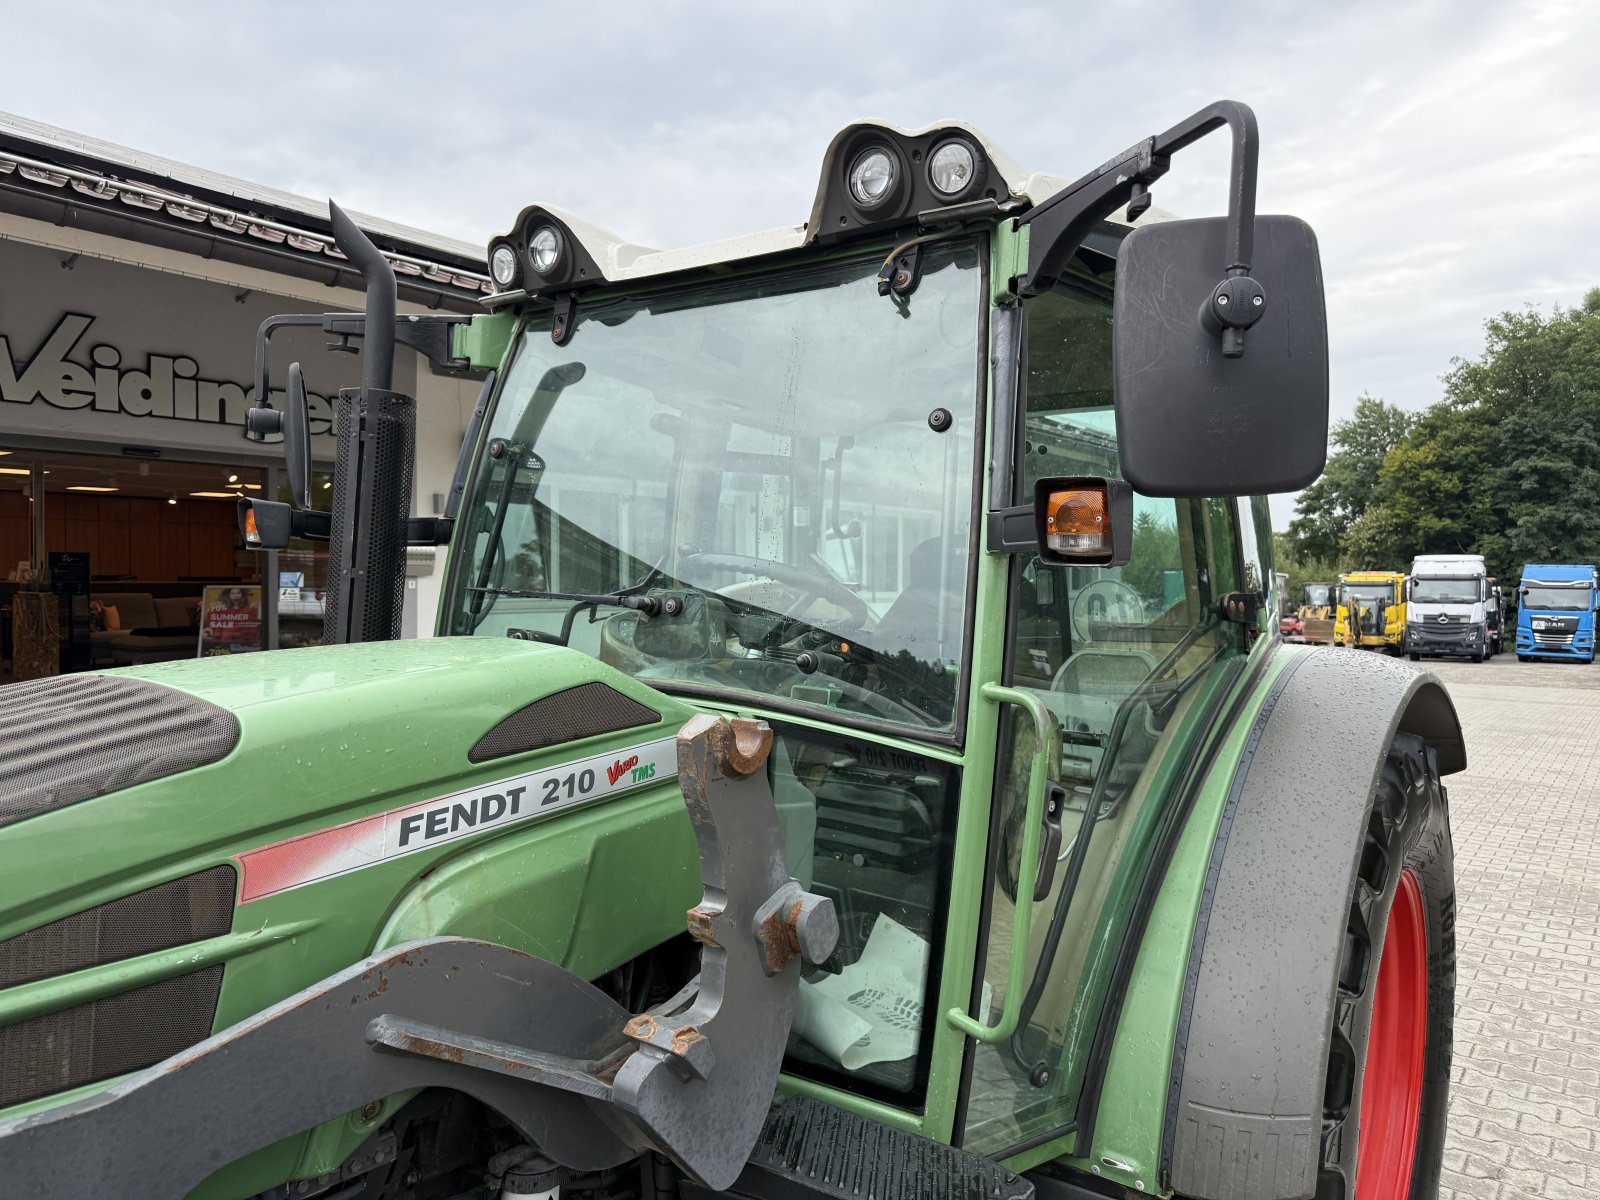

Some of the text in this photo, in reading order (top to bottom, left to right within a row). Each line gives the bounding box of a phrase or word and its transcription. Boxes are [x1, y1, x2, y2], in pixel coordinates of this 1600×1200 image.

[398, 786, 526, 847] FENDT
[541, 768, 595, 805] 210
[631, 762, 656, 783] TMS
